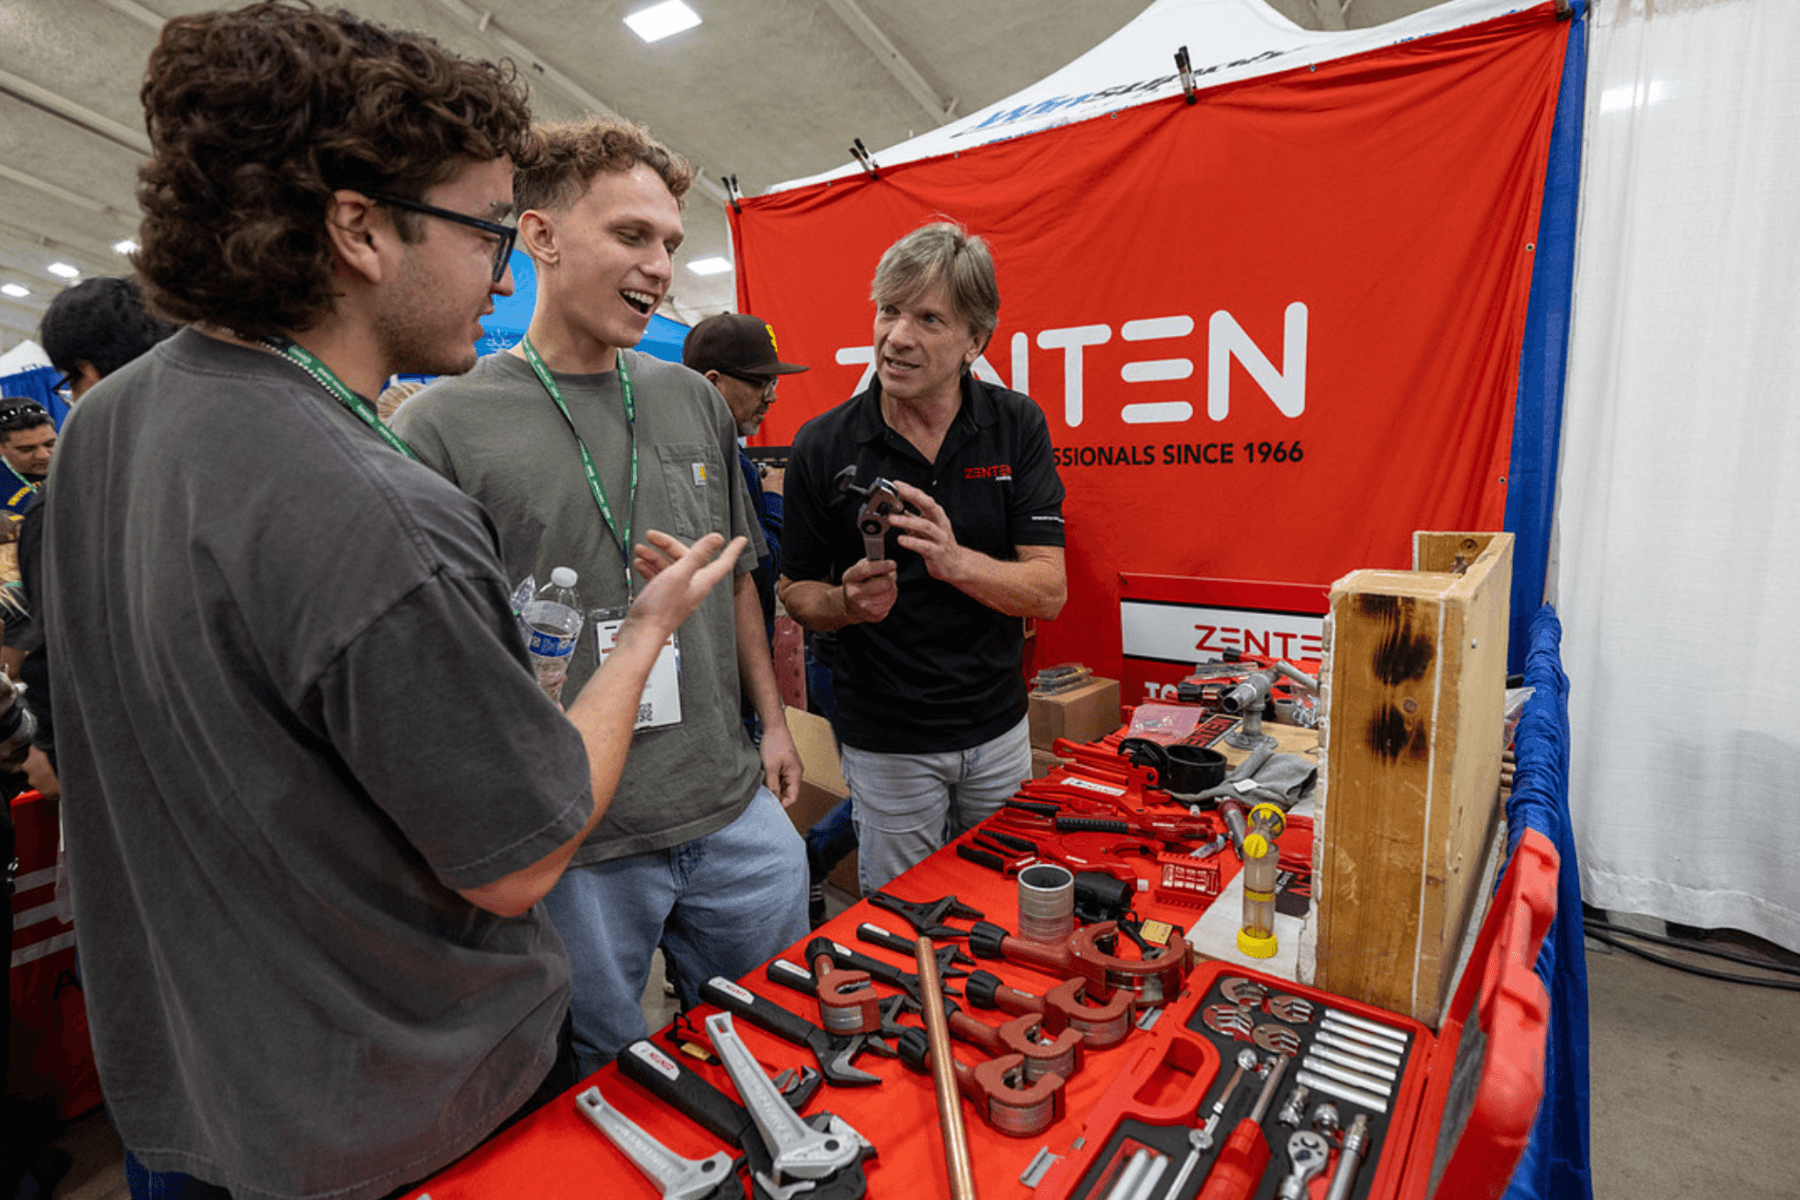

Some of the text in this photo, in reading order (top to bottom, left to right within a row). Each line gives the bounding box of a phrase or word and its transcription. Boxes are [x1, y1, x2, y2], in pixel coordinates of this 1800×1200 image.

[1052, 440, 1305, 467] SSIONALS SINCE 1966
[1194, 624, 1322, 662] ZENTE
